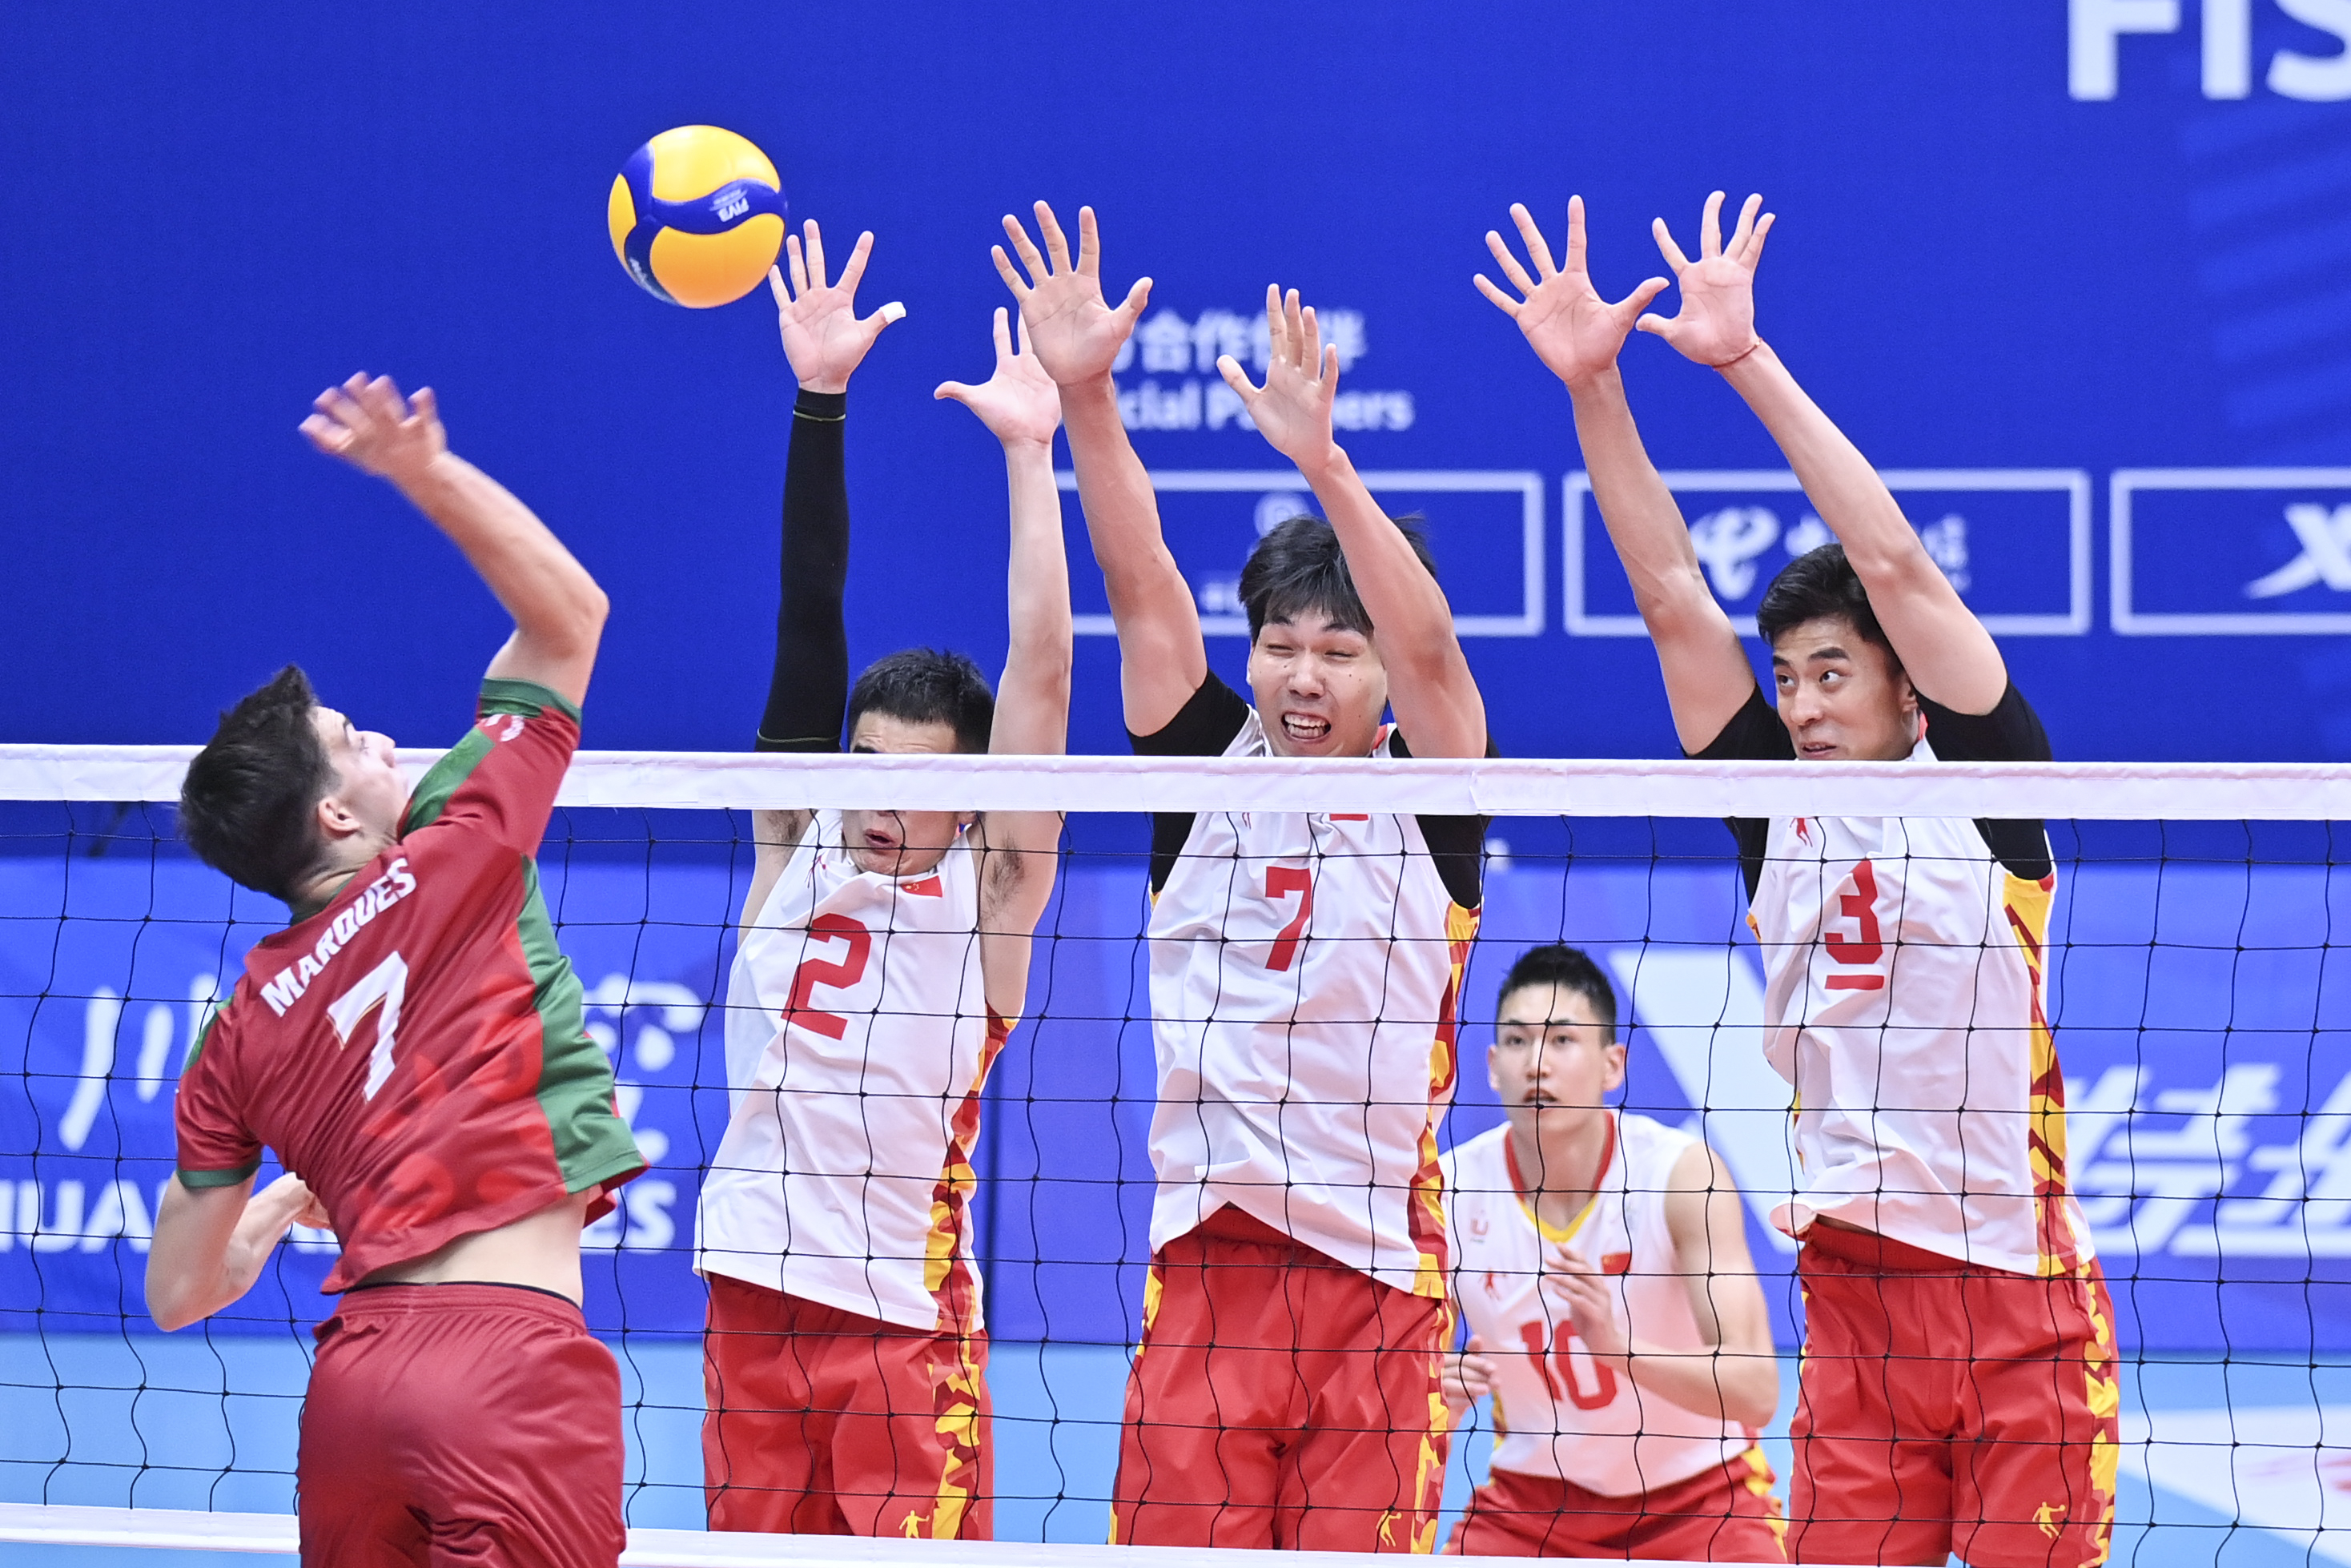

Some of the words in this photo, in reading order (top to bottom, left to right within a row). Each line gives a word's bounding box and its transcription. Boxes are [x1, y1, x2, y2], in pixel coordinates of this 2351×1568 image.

[259, 858, 416, 1018] MARQUES
[1265, 866, 1312, 971] 7
[1825, 858, 1884, 965] 3
[324, 951, 409, 1105] 7
[781, 912, 872, 1041] 2
[1519, 1319, 1618, 1412] 10
